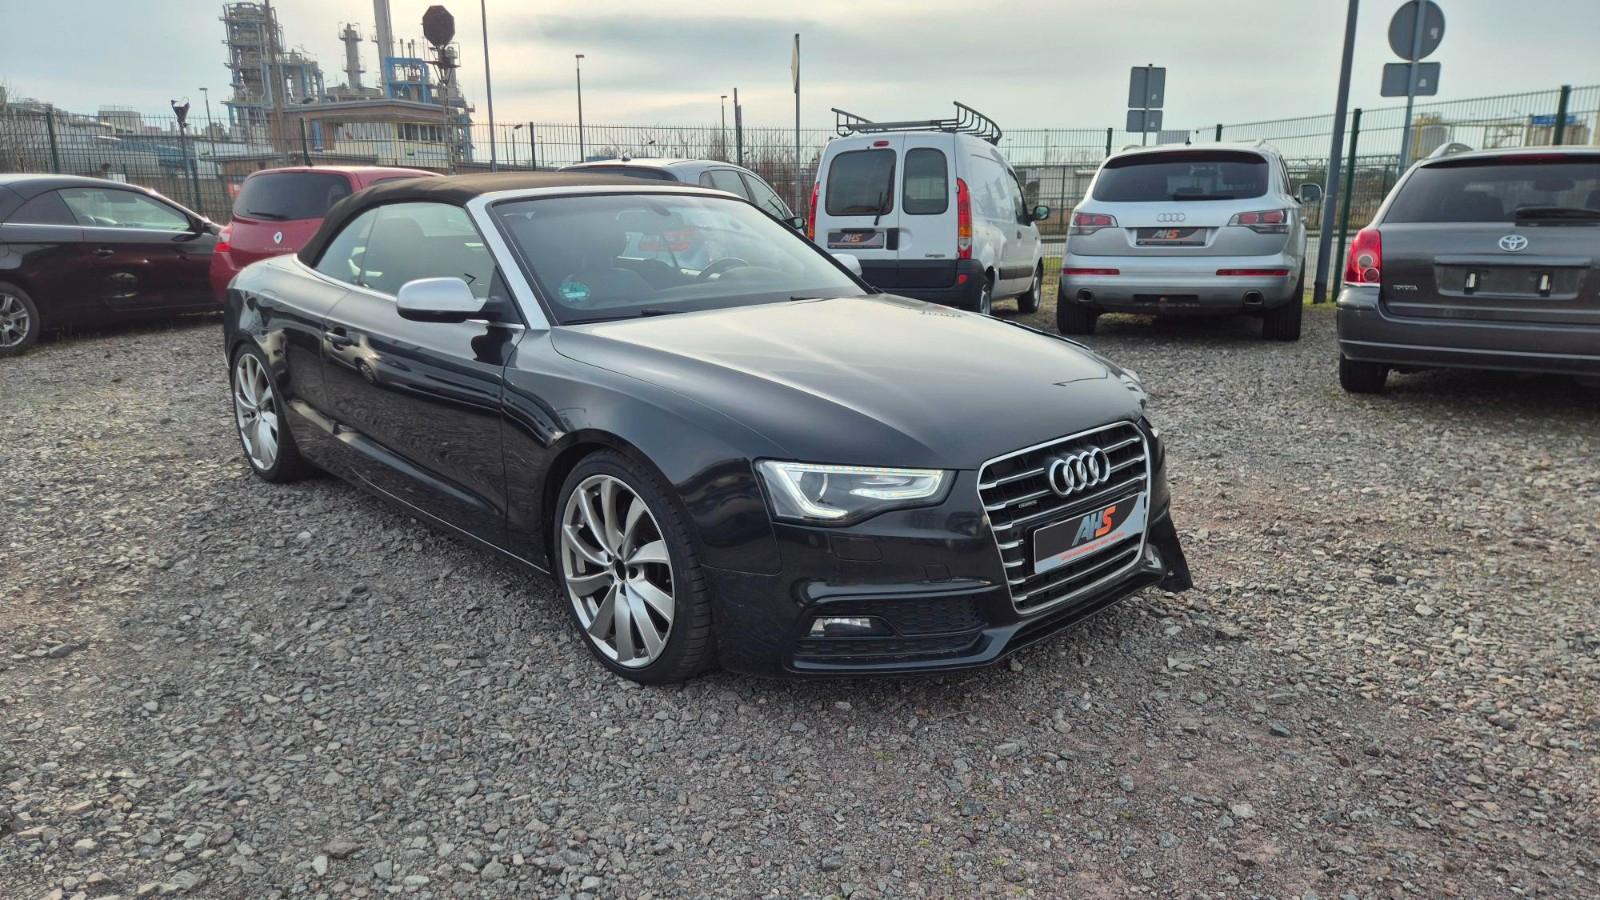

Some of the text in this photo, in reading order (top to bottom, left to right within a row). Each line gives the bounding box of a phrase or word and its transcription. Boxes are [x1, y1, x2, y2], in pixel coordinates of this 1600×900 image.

[840, 233, 863, 243] AHS
[1152, 228, 1180, 239] AHS
[1072, 505, 1117, 546] AHS
